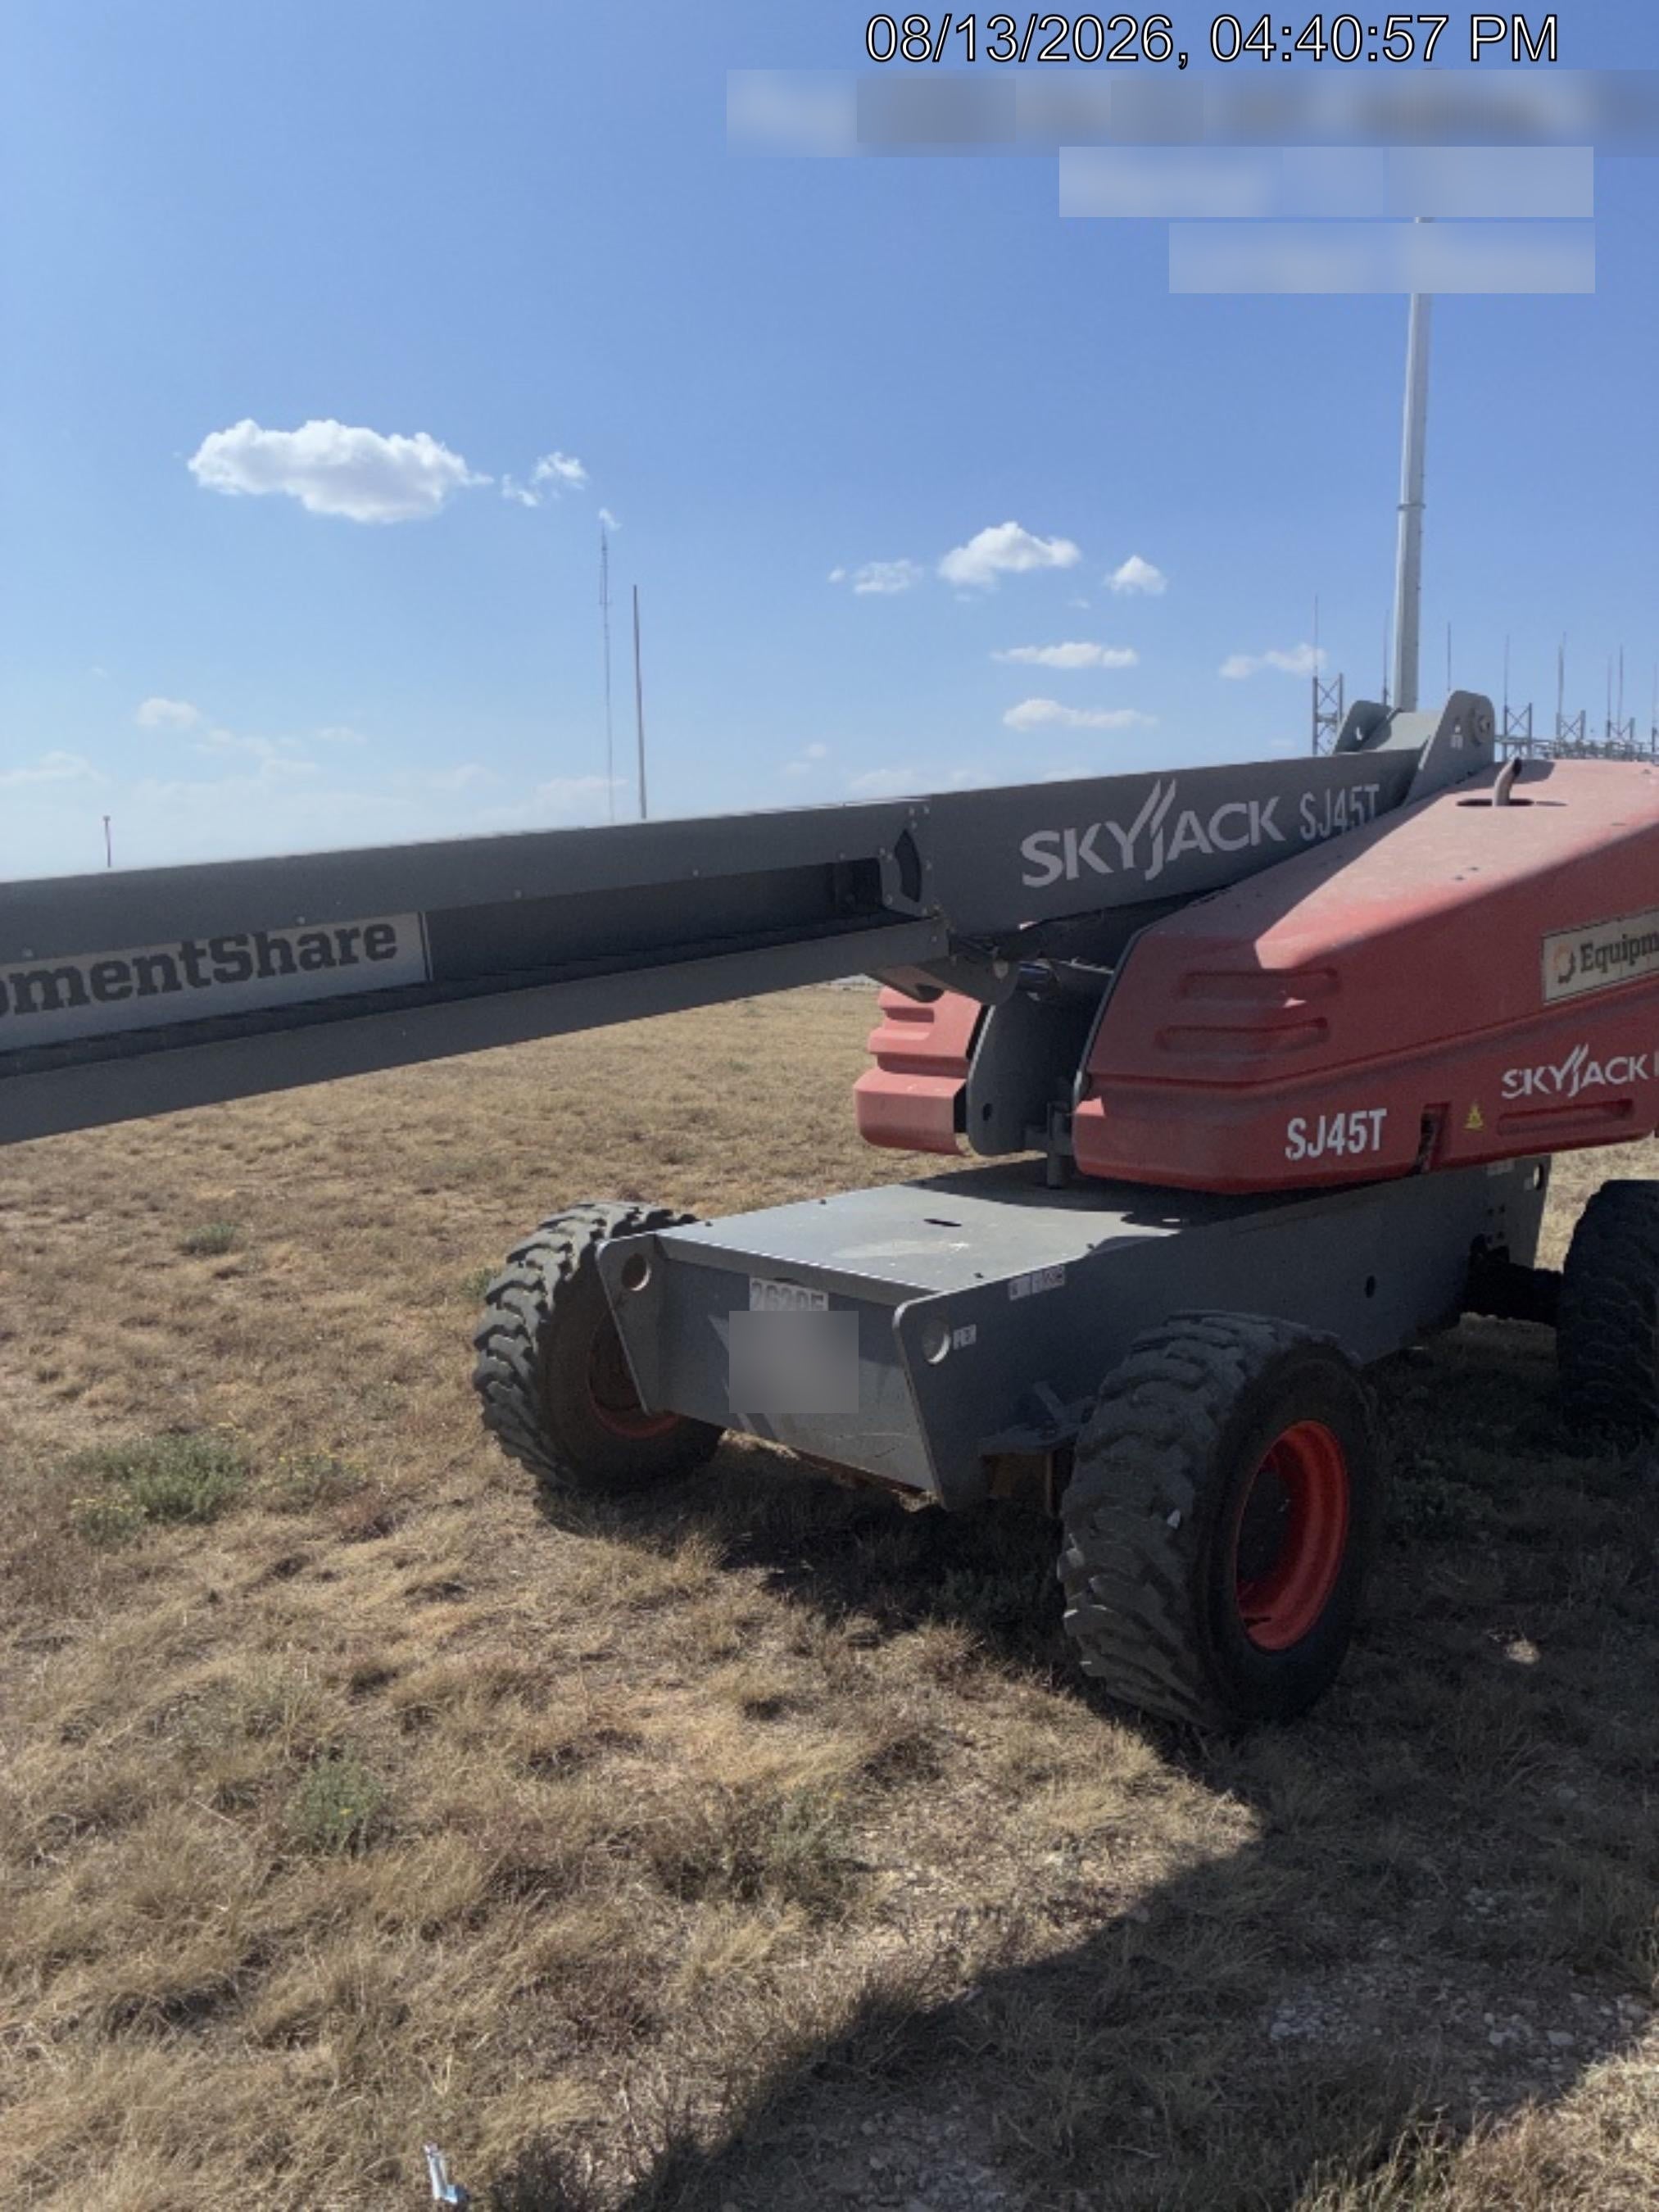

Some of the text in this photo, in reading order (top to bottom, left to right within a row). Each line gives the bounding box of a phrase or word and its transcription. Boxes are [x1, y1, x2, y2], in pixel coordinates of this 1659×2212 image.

[1020, 778, 1380, 887] SKYJACK SJ45T
[0, 922, 397, 1018] mentShare
[1502, 1043, 1649, 1099] SKYJACK
[1285, 1108, 1387, 1161] SJ45T
